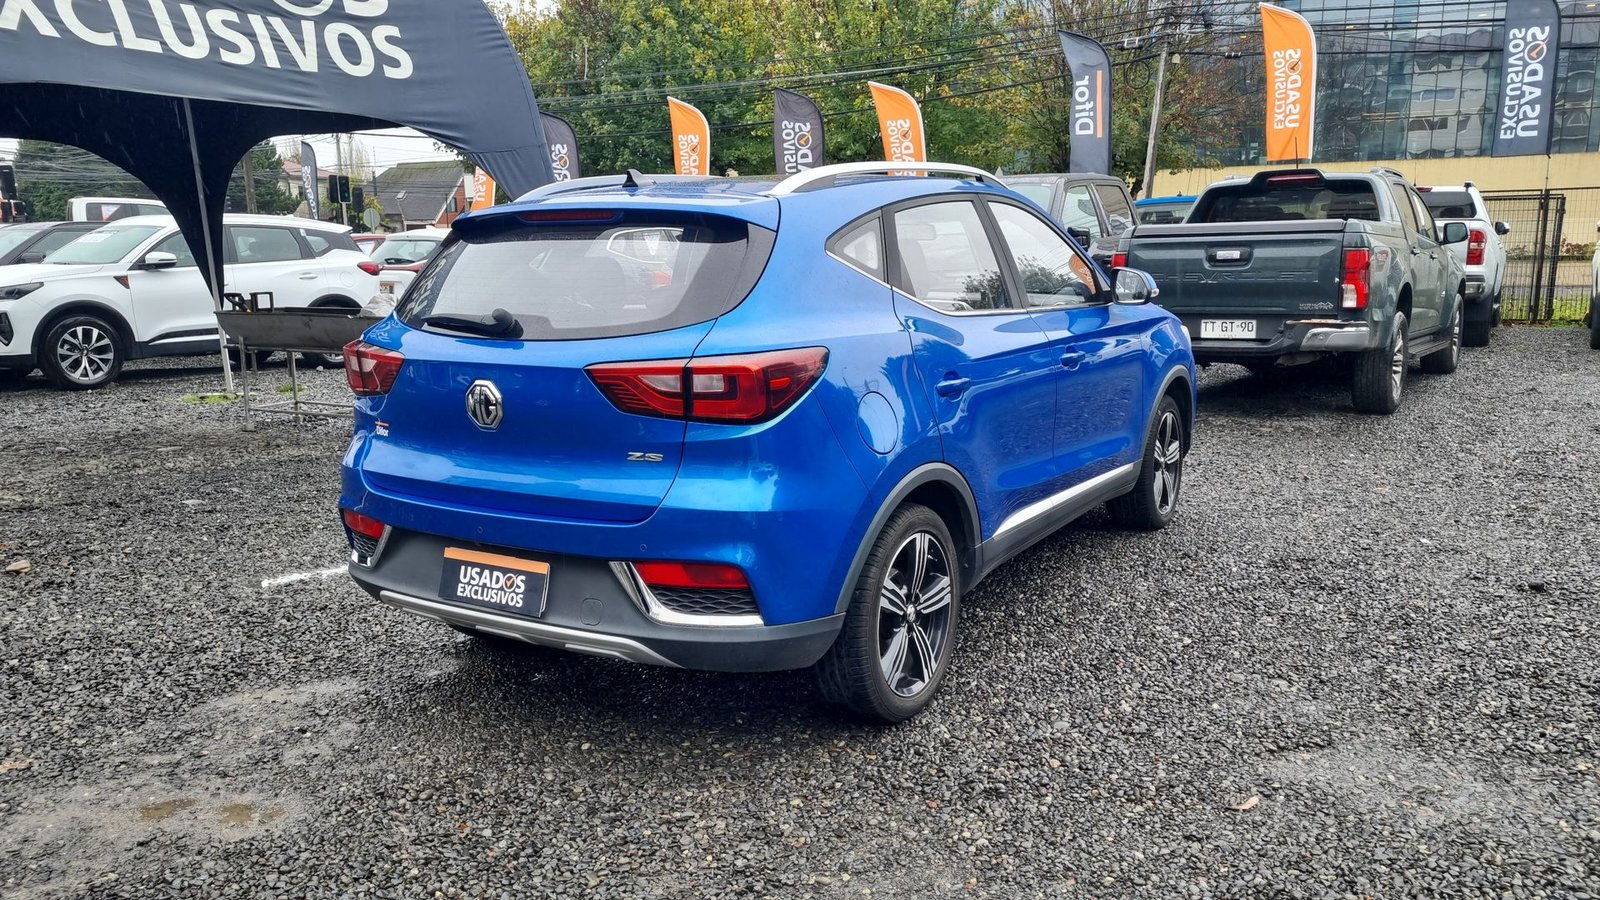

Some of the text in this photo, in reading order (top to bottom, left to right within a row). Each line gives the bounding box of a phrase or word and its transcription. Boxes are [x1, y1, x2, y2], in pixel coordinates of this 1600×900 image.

[0, 0, 413, 79] XCLUSIVOS
[468, 383, 500, 427] MG
[627, 452, 663, 462] ZS
[460, 565, 526, 593] USADOS
[457, 582, 524, 608] EXCLUSIVOS
